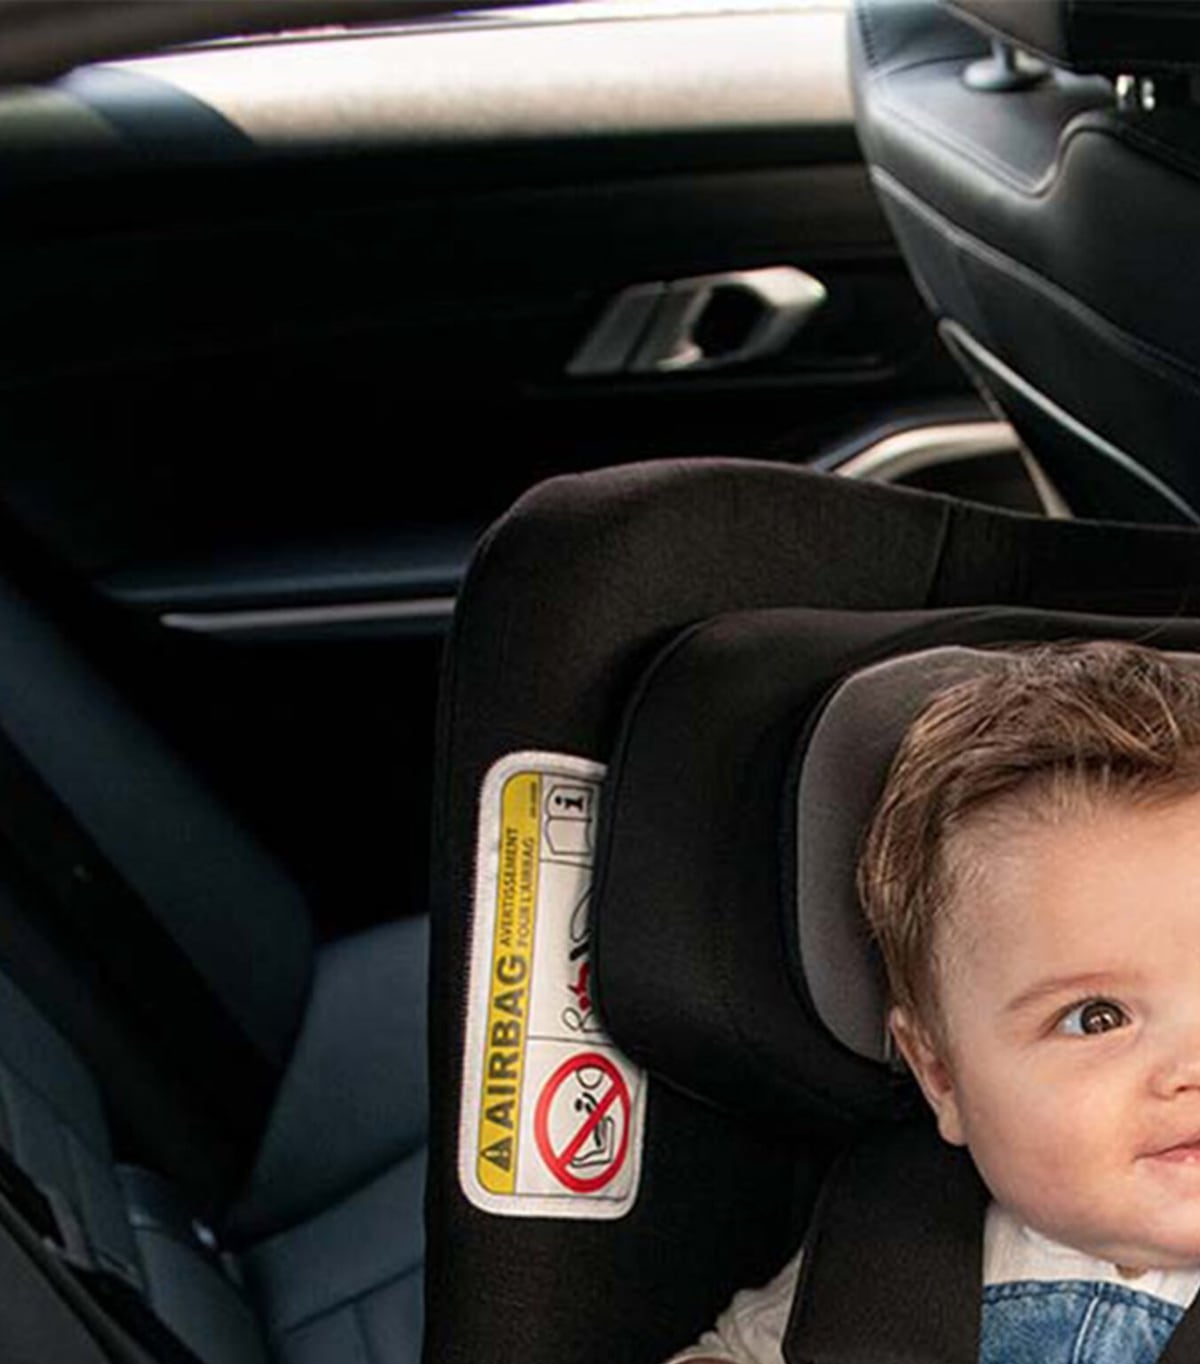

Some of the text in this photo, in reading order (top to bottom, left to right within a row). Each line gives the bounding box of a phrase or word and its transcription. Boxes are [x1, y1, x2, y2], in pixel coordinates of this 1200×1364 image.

[499, 827, 519, 948] AVERTISSEMENT
[517, 906, 530, 947] POUR
[485, 955, 527, 1129] AIRBAG
